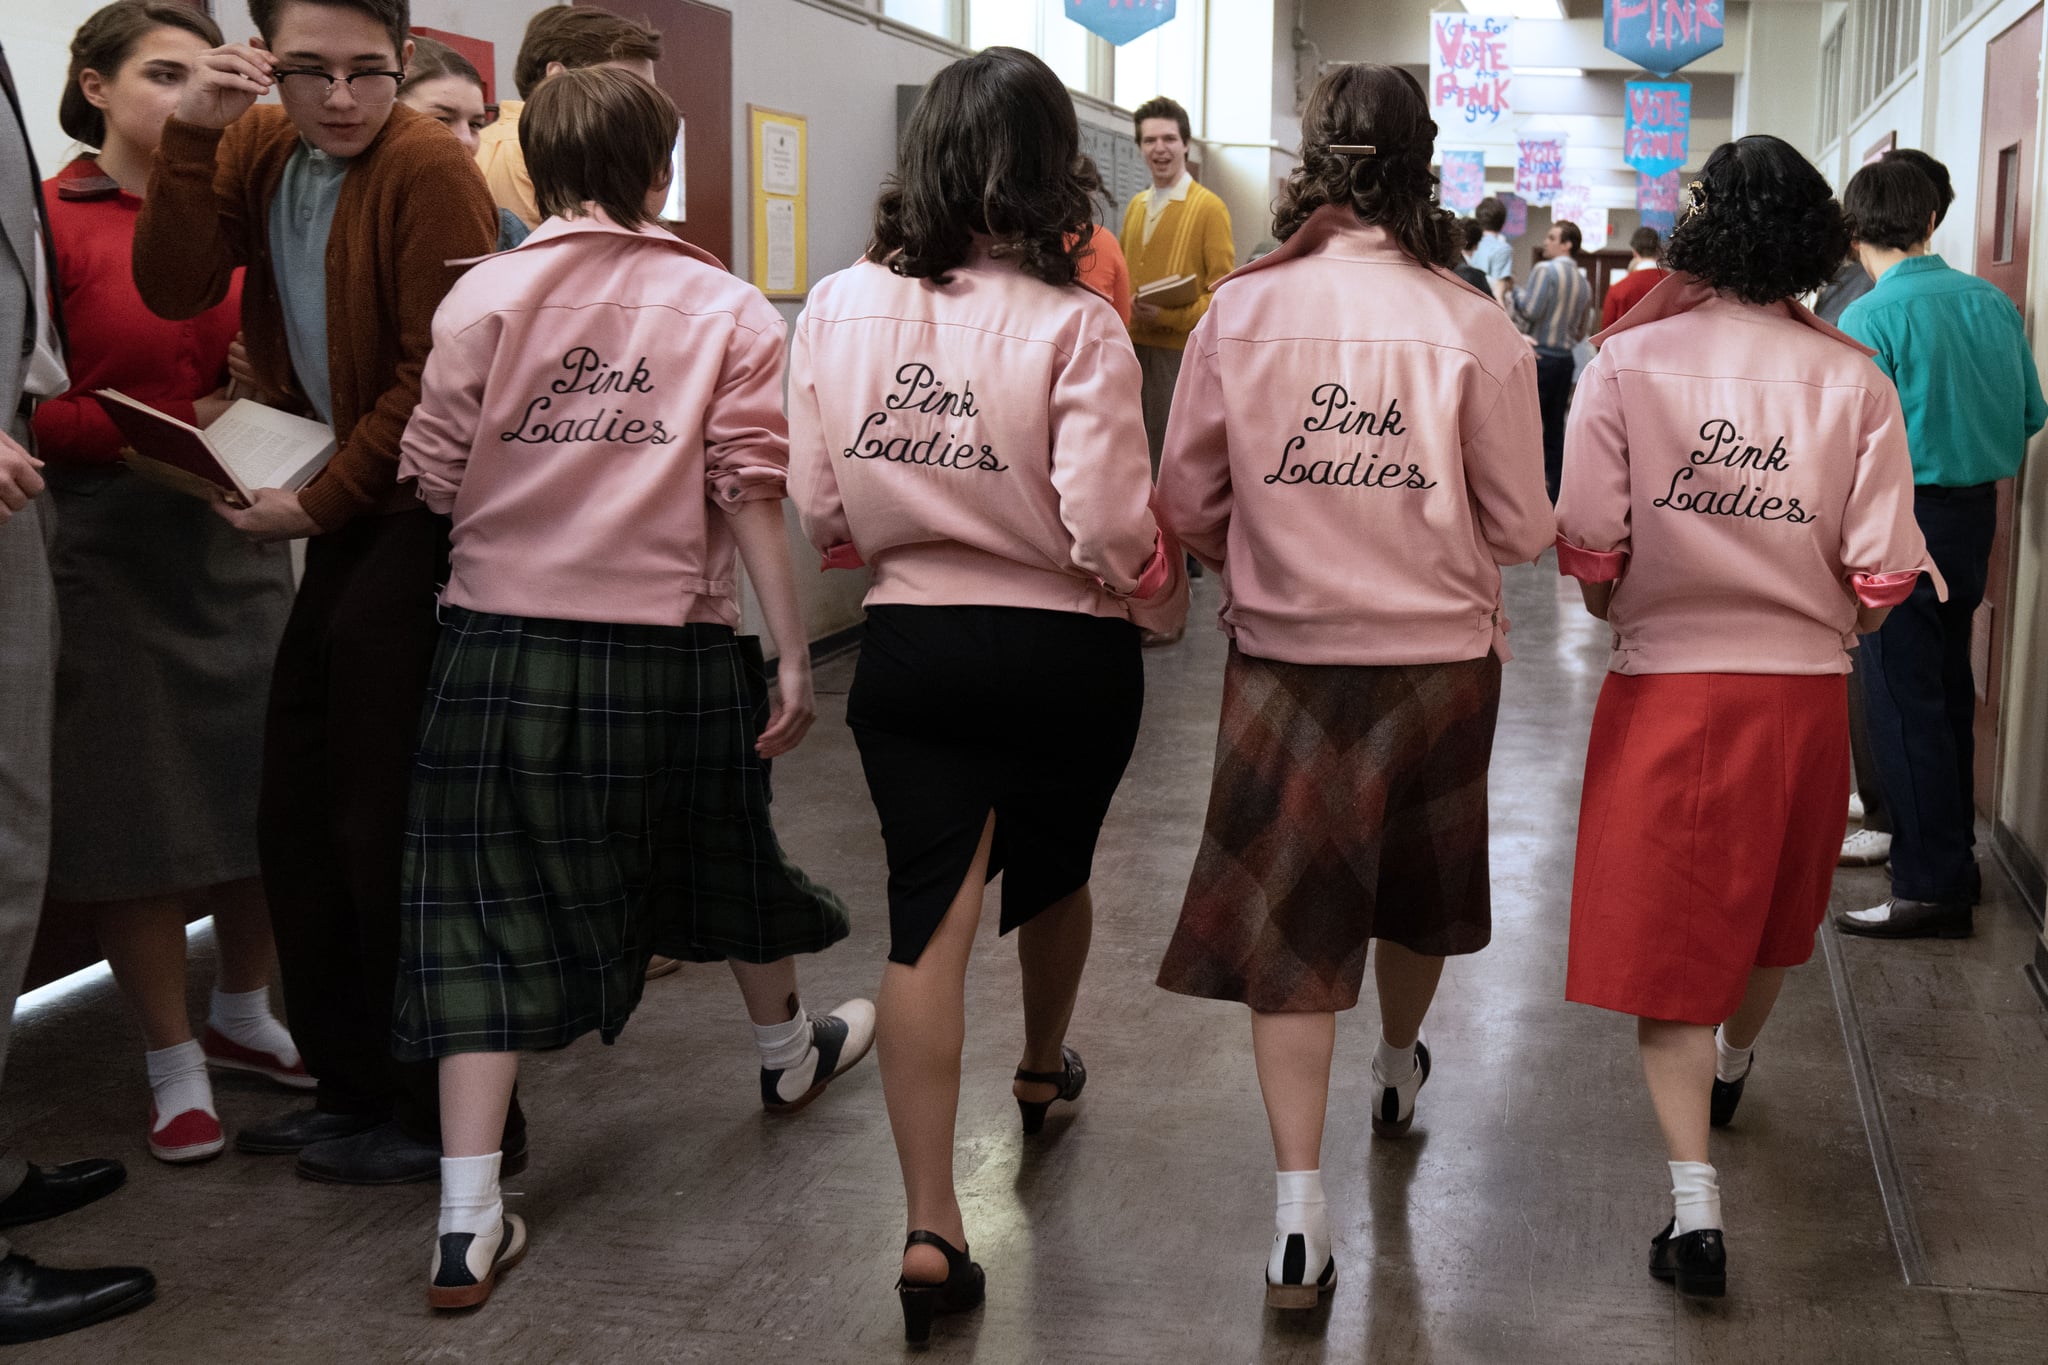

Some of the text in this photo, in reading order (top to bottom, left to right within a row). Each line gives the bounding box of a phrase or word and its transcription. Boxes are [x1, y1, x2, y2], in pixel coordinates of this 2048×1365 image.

[1436, 21, 1510, 70] VOTE
[1612, 0, 1723, 51] PINK
[1436, 73, 1512, 111] PINK
[1629, 88, 1688, 127] VOTE
[1625, 130, 1686, 160] PINK
[551, 346, 655, 395] Pink
[886, 362, 979, 417] Pink
[500, 396, 678, 445] Ladies
[1303, 383, 1406, 436] Pink
[843, 412, 1009, 472] Ladies
[1263, 435, 1438, 490] Ladies
[1690, 419, 1790, 471] Pink
[1653, 466, 1817, 524] Ladies
